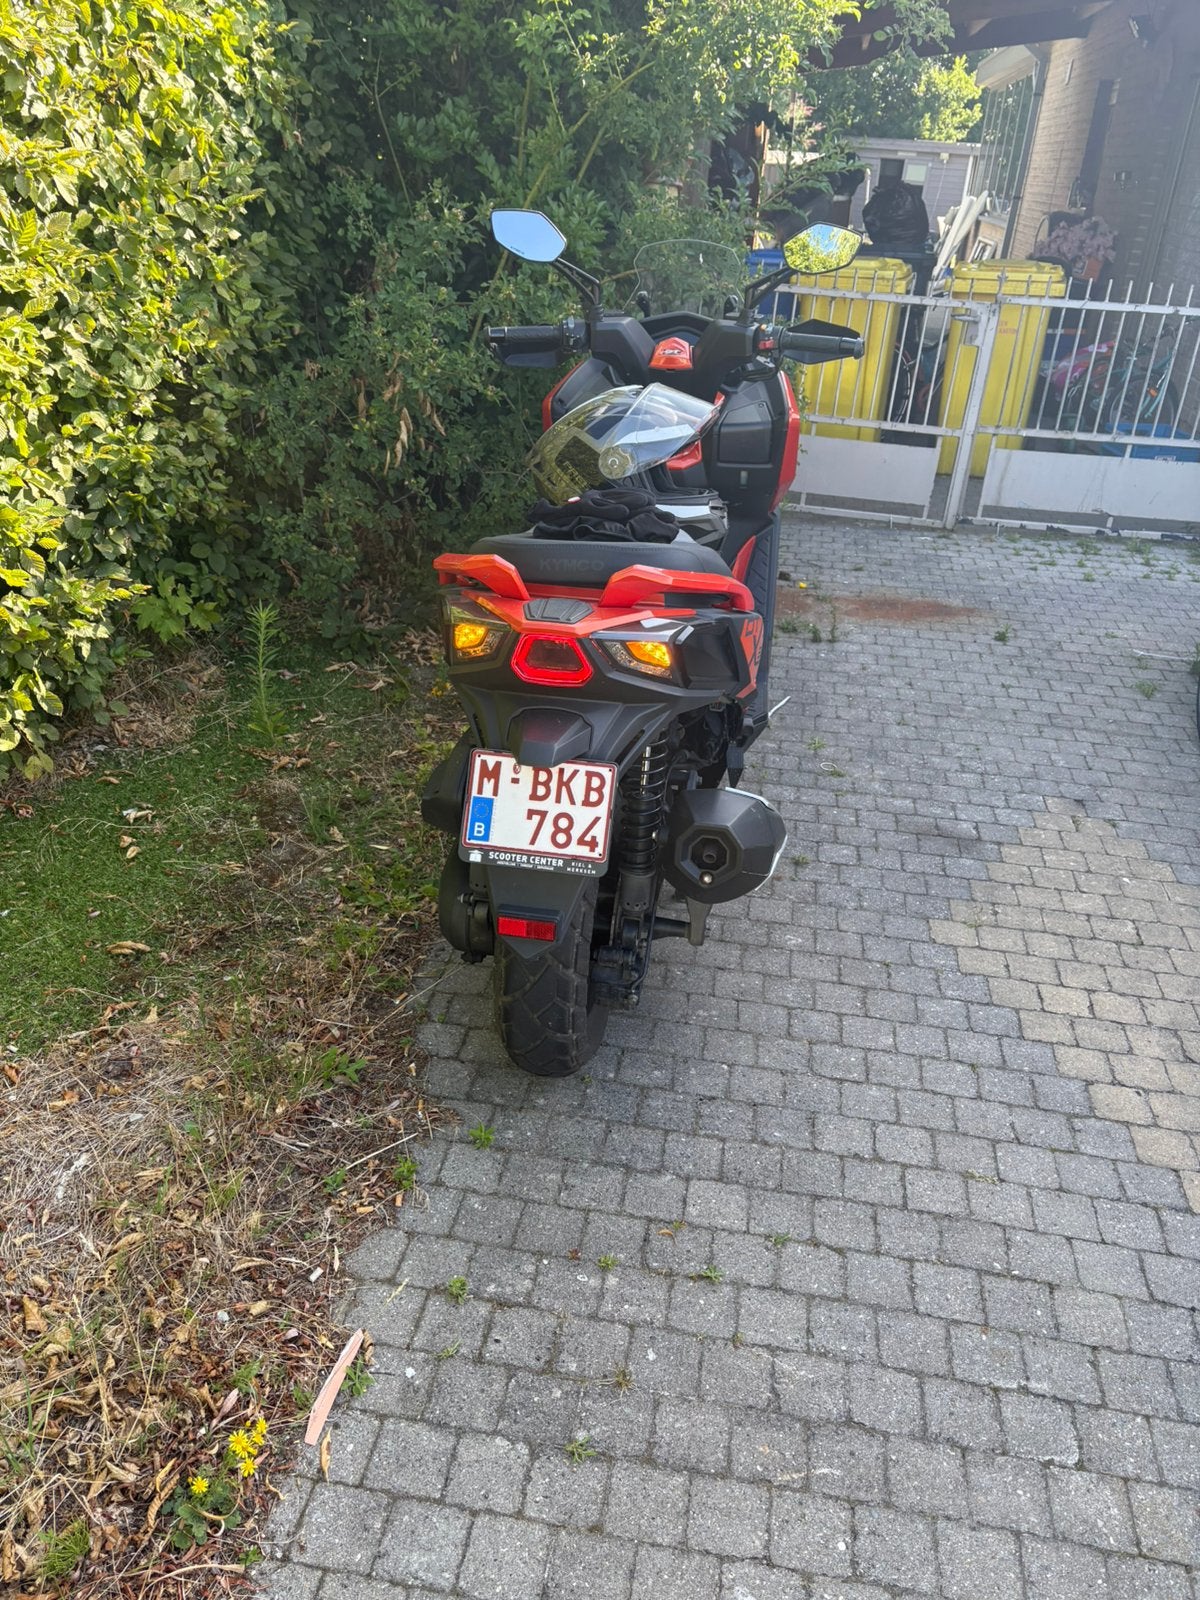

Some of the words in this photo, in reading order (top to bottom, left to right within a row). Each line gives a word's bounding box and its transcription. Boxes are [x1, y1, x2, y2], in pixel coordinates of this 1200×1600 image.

[540, 559, 605, 572] KYMCO
[473, 822, 485, 837] B
[526, 808, 602, 853] 784
[489, 851, 528, 863] SCOOTER
[529, 855, 564, 867] CENTER
